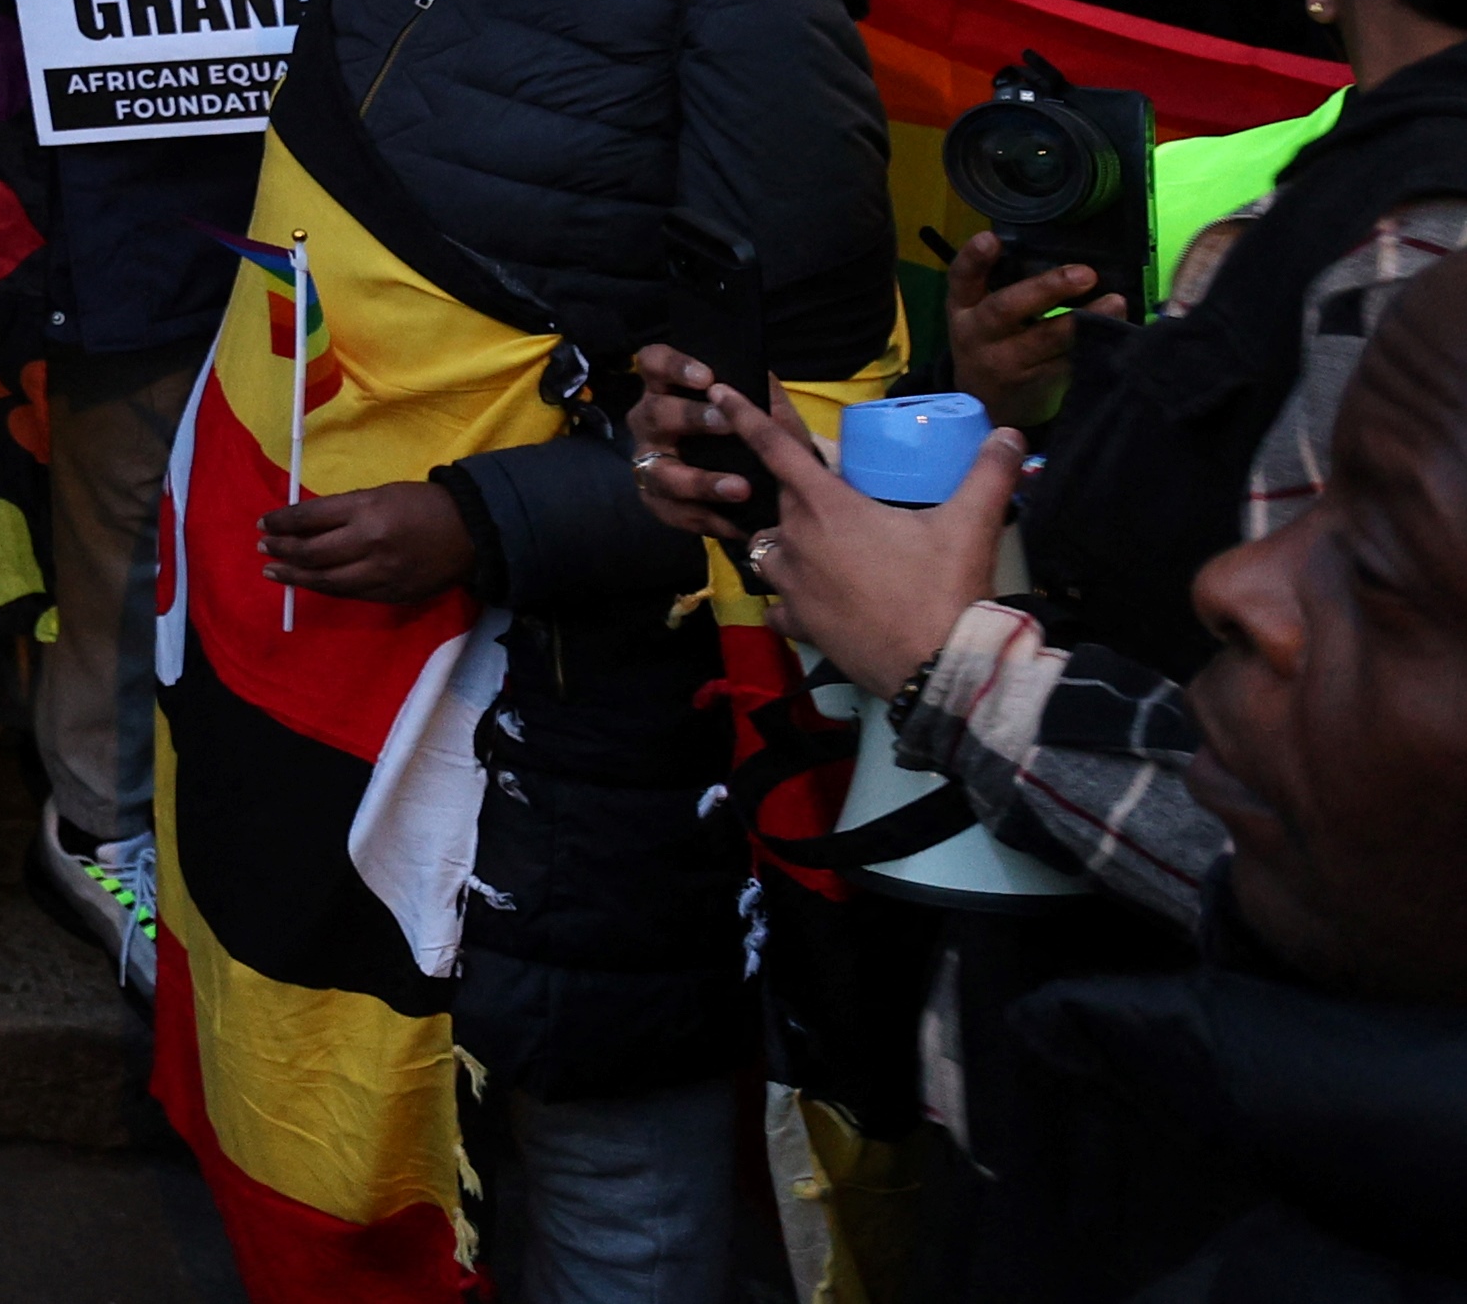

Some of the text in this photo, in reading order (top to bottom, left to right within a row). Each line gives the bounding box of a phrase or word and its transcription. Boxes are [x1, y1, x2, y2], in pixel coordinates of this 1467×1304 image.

[67, 59, 290, 95] AFRICAN EQUA
[115, 89, 271, 121] FOUNDATI
